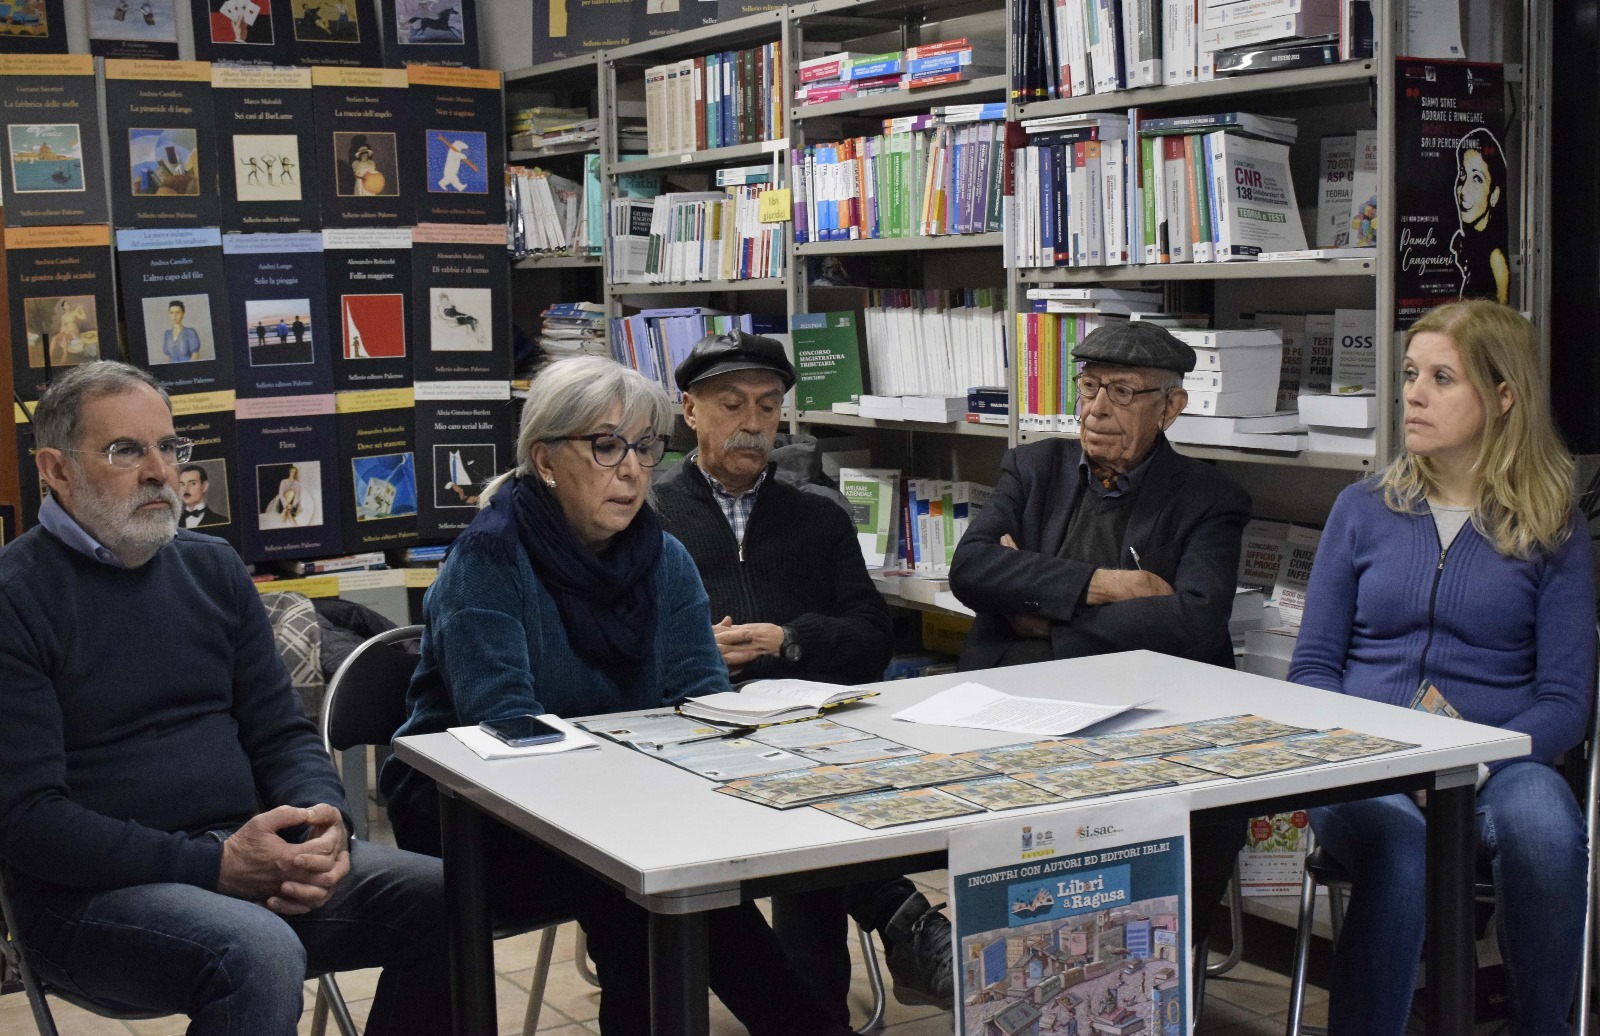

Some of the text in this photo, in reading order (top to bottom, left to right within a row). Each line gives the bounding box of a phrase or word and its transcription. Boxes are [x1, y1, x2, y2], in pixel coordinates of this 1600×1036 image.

[741, 5, 761, 13] Sellerio
[582, 39, 600, 48] Sellerio
[601, 38, 619, 47] editore
[1421, 97, 1439, 108] SIAMO
[1440, 98, 1457, 109] STATE
[130, 104, 140, 112] La
[140, 105, 167, 113] piramide
[335, 109, 343, 117] La
[234, 112, 244, 120] Sei
[245, 112, 257, 120] casi
[265, 112, 293, 120] BarLume
[1421, 110, 1447, 122] ADORATE
[1421, 137, 1436, 148] SOLO
[1327, 160, 1337, 170] 70
[1235, 167, 1263, 189] CNR
[1327, 171, 1344, 183] ASP
[1236, 186, 1253, 200] 138
[1326, 188, 1349, 198] TEORIA
[768, 196, 779, 206] libri
[763, 211, 786, 222] giuridici
[1239, 208, 1261, 220] TEORIA
[1268, 213, 1285, 223] TEST
[1400, 227, 1438, 252] Pamela
[150, 257, 193, 267] Andrea Camilleri
[431, 265, 440, 273] Di
[143, 271, 204, 282] L'altro capo del filo
[254, 277, 299, 286] Solo la pioggia
[349, 272, 395, 281] Follia maggiore
[1312, 337, 1334, 346] TEST
[1341, 335, 1373, 349] OSS
[799, 349, 831, 357] CONCORSO
[800, 354, 845, 362] MAGISTRATURA
[800, 360, 836, 368] TRIBUTARIA
[1310, 356, 1328, 366] PER
[348, 373, 366, 381] Sellerio
[384, 372, 404, 380] Palermo
[434, 422, 447, 430] Mio
[462, 422, 477, 430] serial
[478, 422, 493, 430] killer
[279, 441, 296, 449] Flora
[1247, 542, 1280, 552] CONCORSO
[1246, 551, 1276, 561] UFFICIO
[1292, 548, 1314, 560] QUIZ
[968, 842, 1171, 888] INCONTRI CON AUTORI ED EDITORI IBLEI
[1063, 888, 1126, 910] a Ragusa
